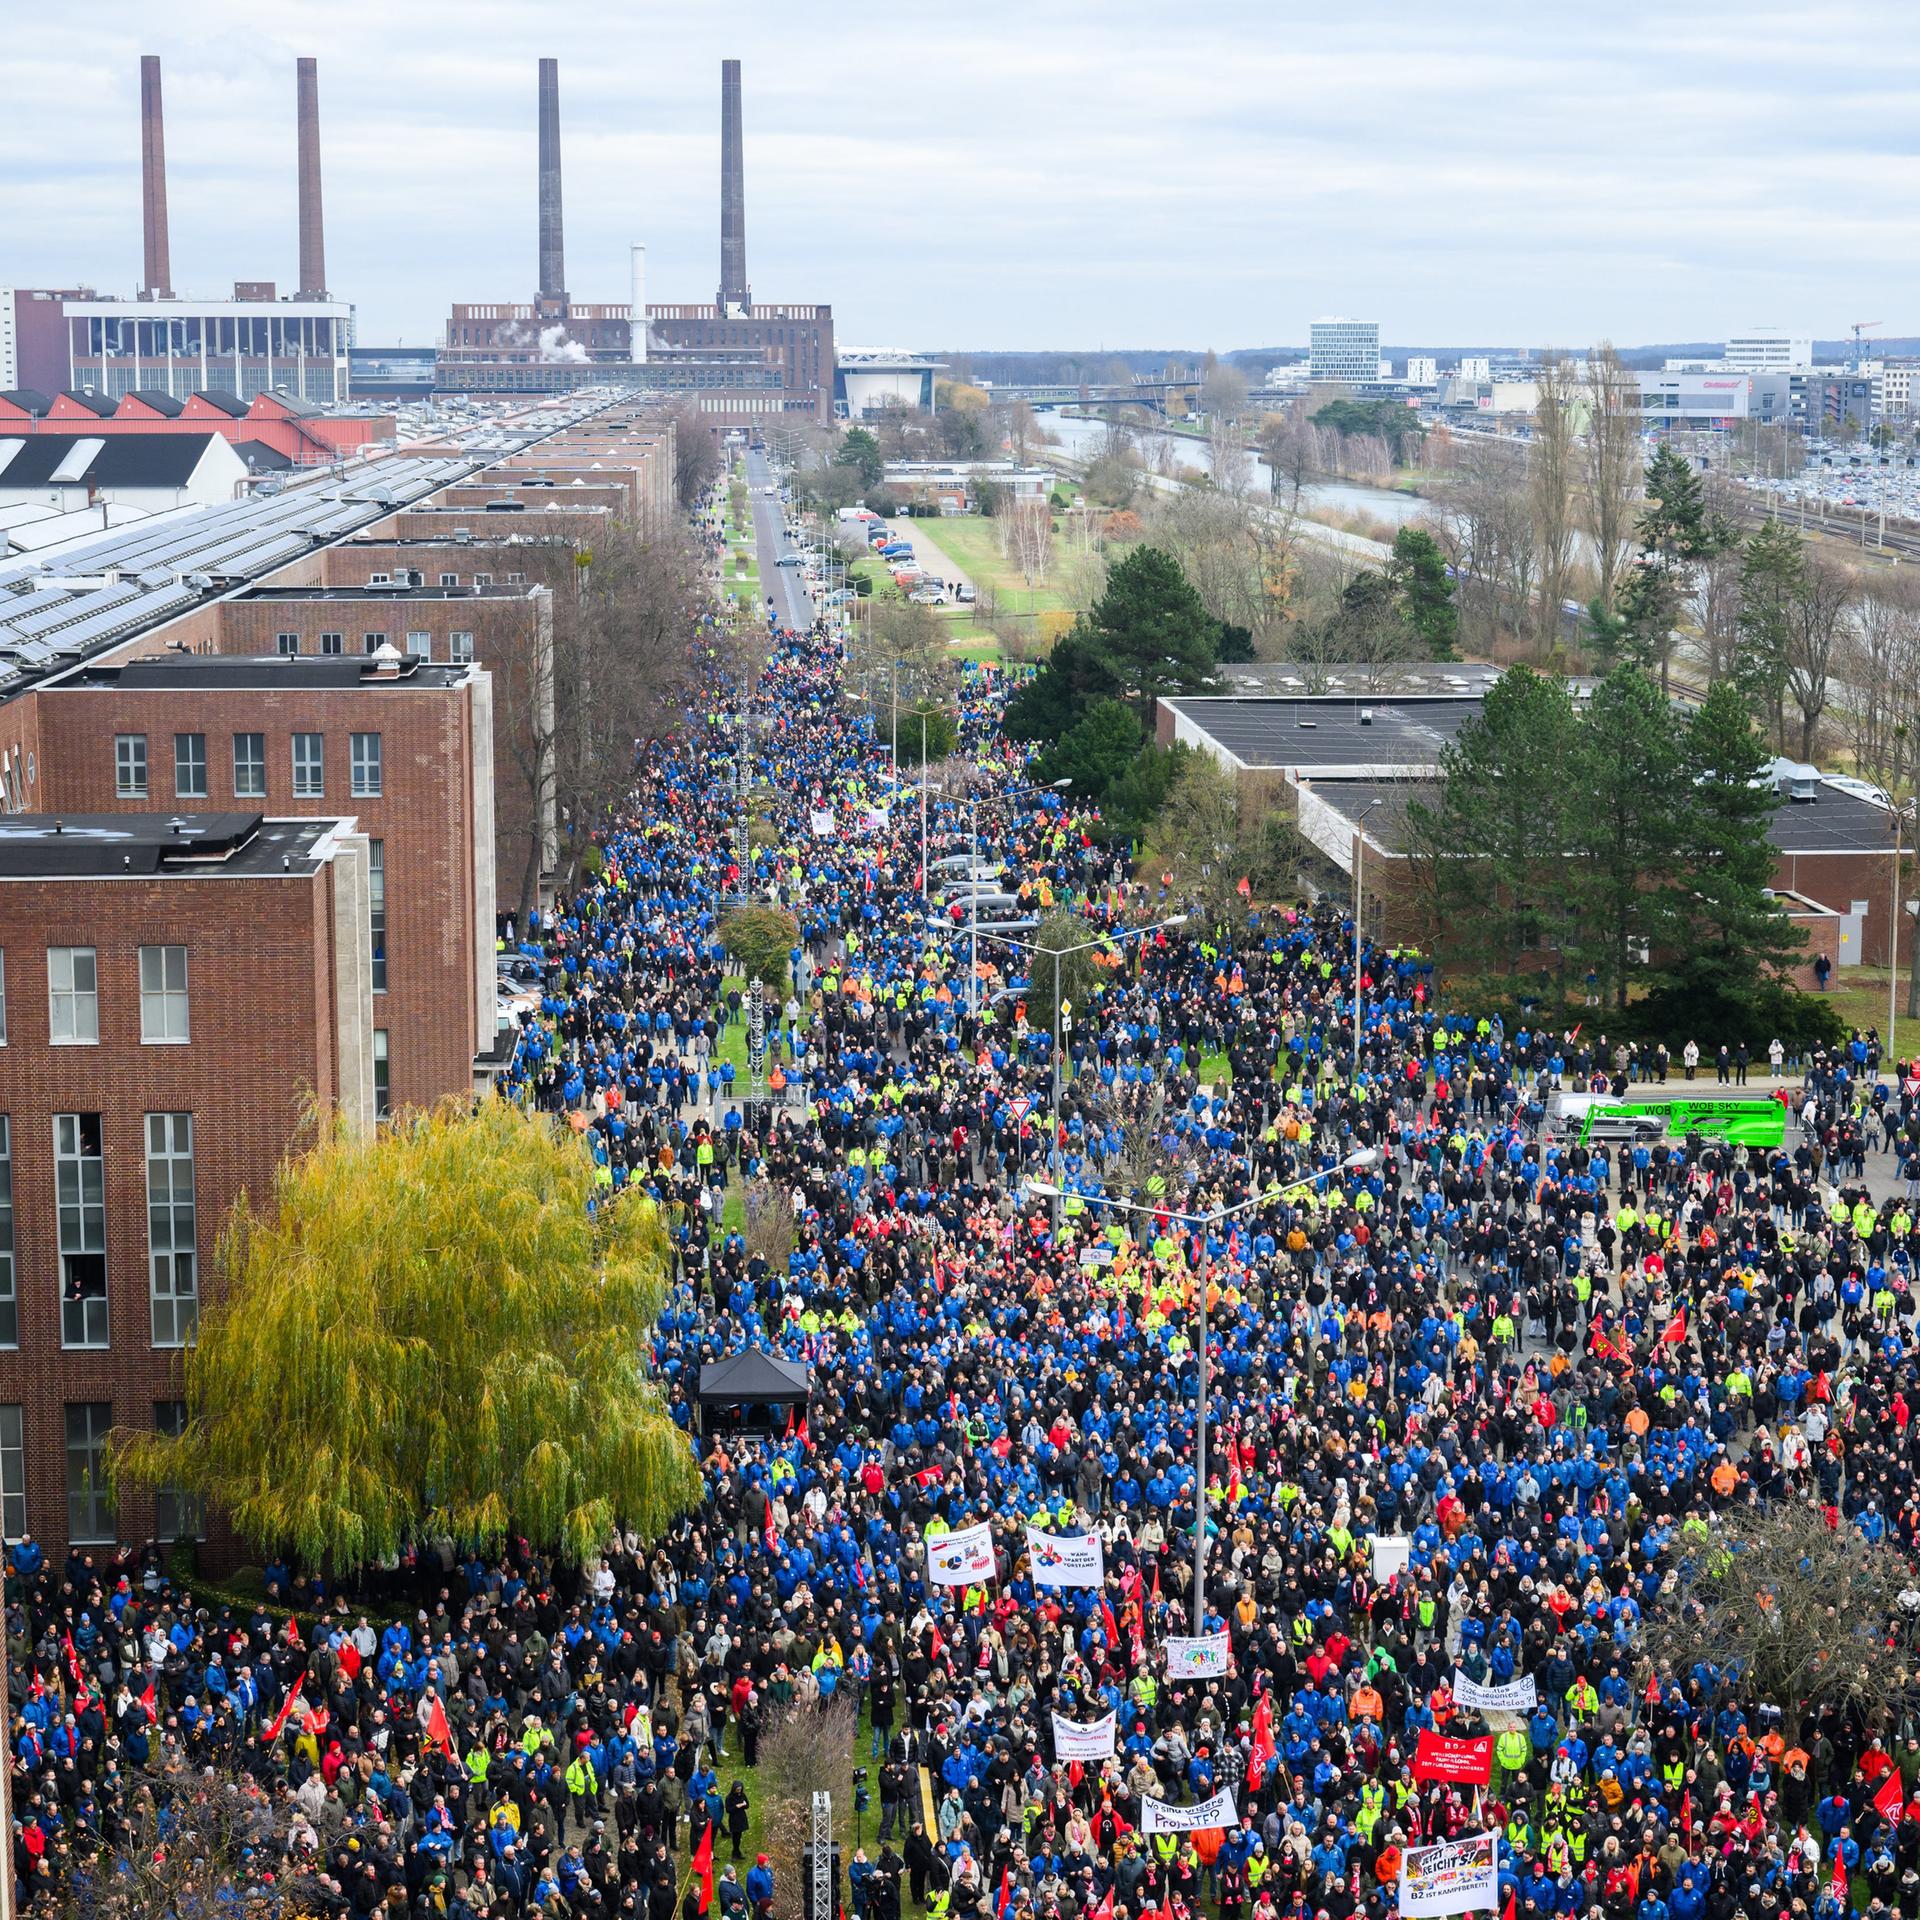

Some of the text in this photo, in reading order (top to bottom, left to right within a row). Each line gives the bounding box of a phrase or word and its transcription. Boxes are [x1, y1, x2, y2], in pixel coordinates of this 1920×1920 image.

[1645, 1105, 1671, 1115] WOB
[1688, 1102, 1740, 1110] WOB-SKY
[1145, 1799, 1159, 1811] Wo
[1421, 1848, 1444, 1866] JETZT
